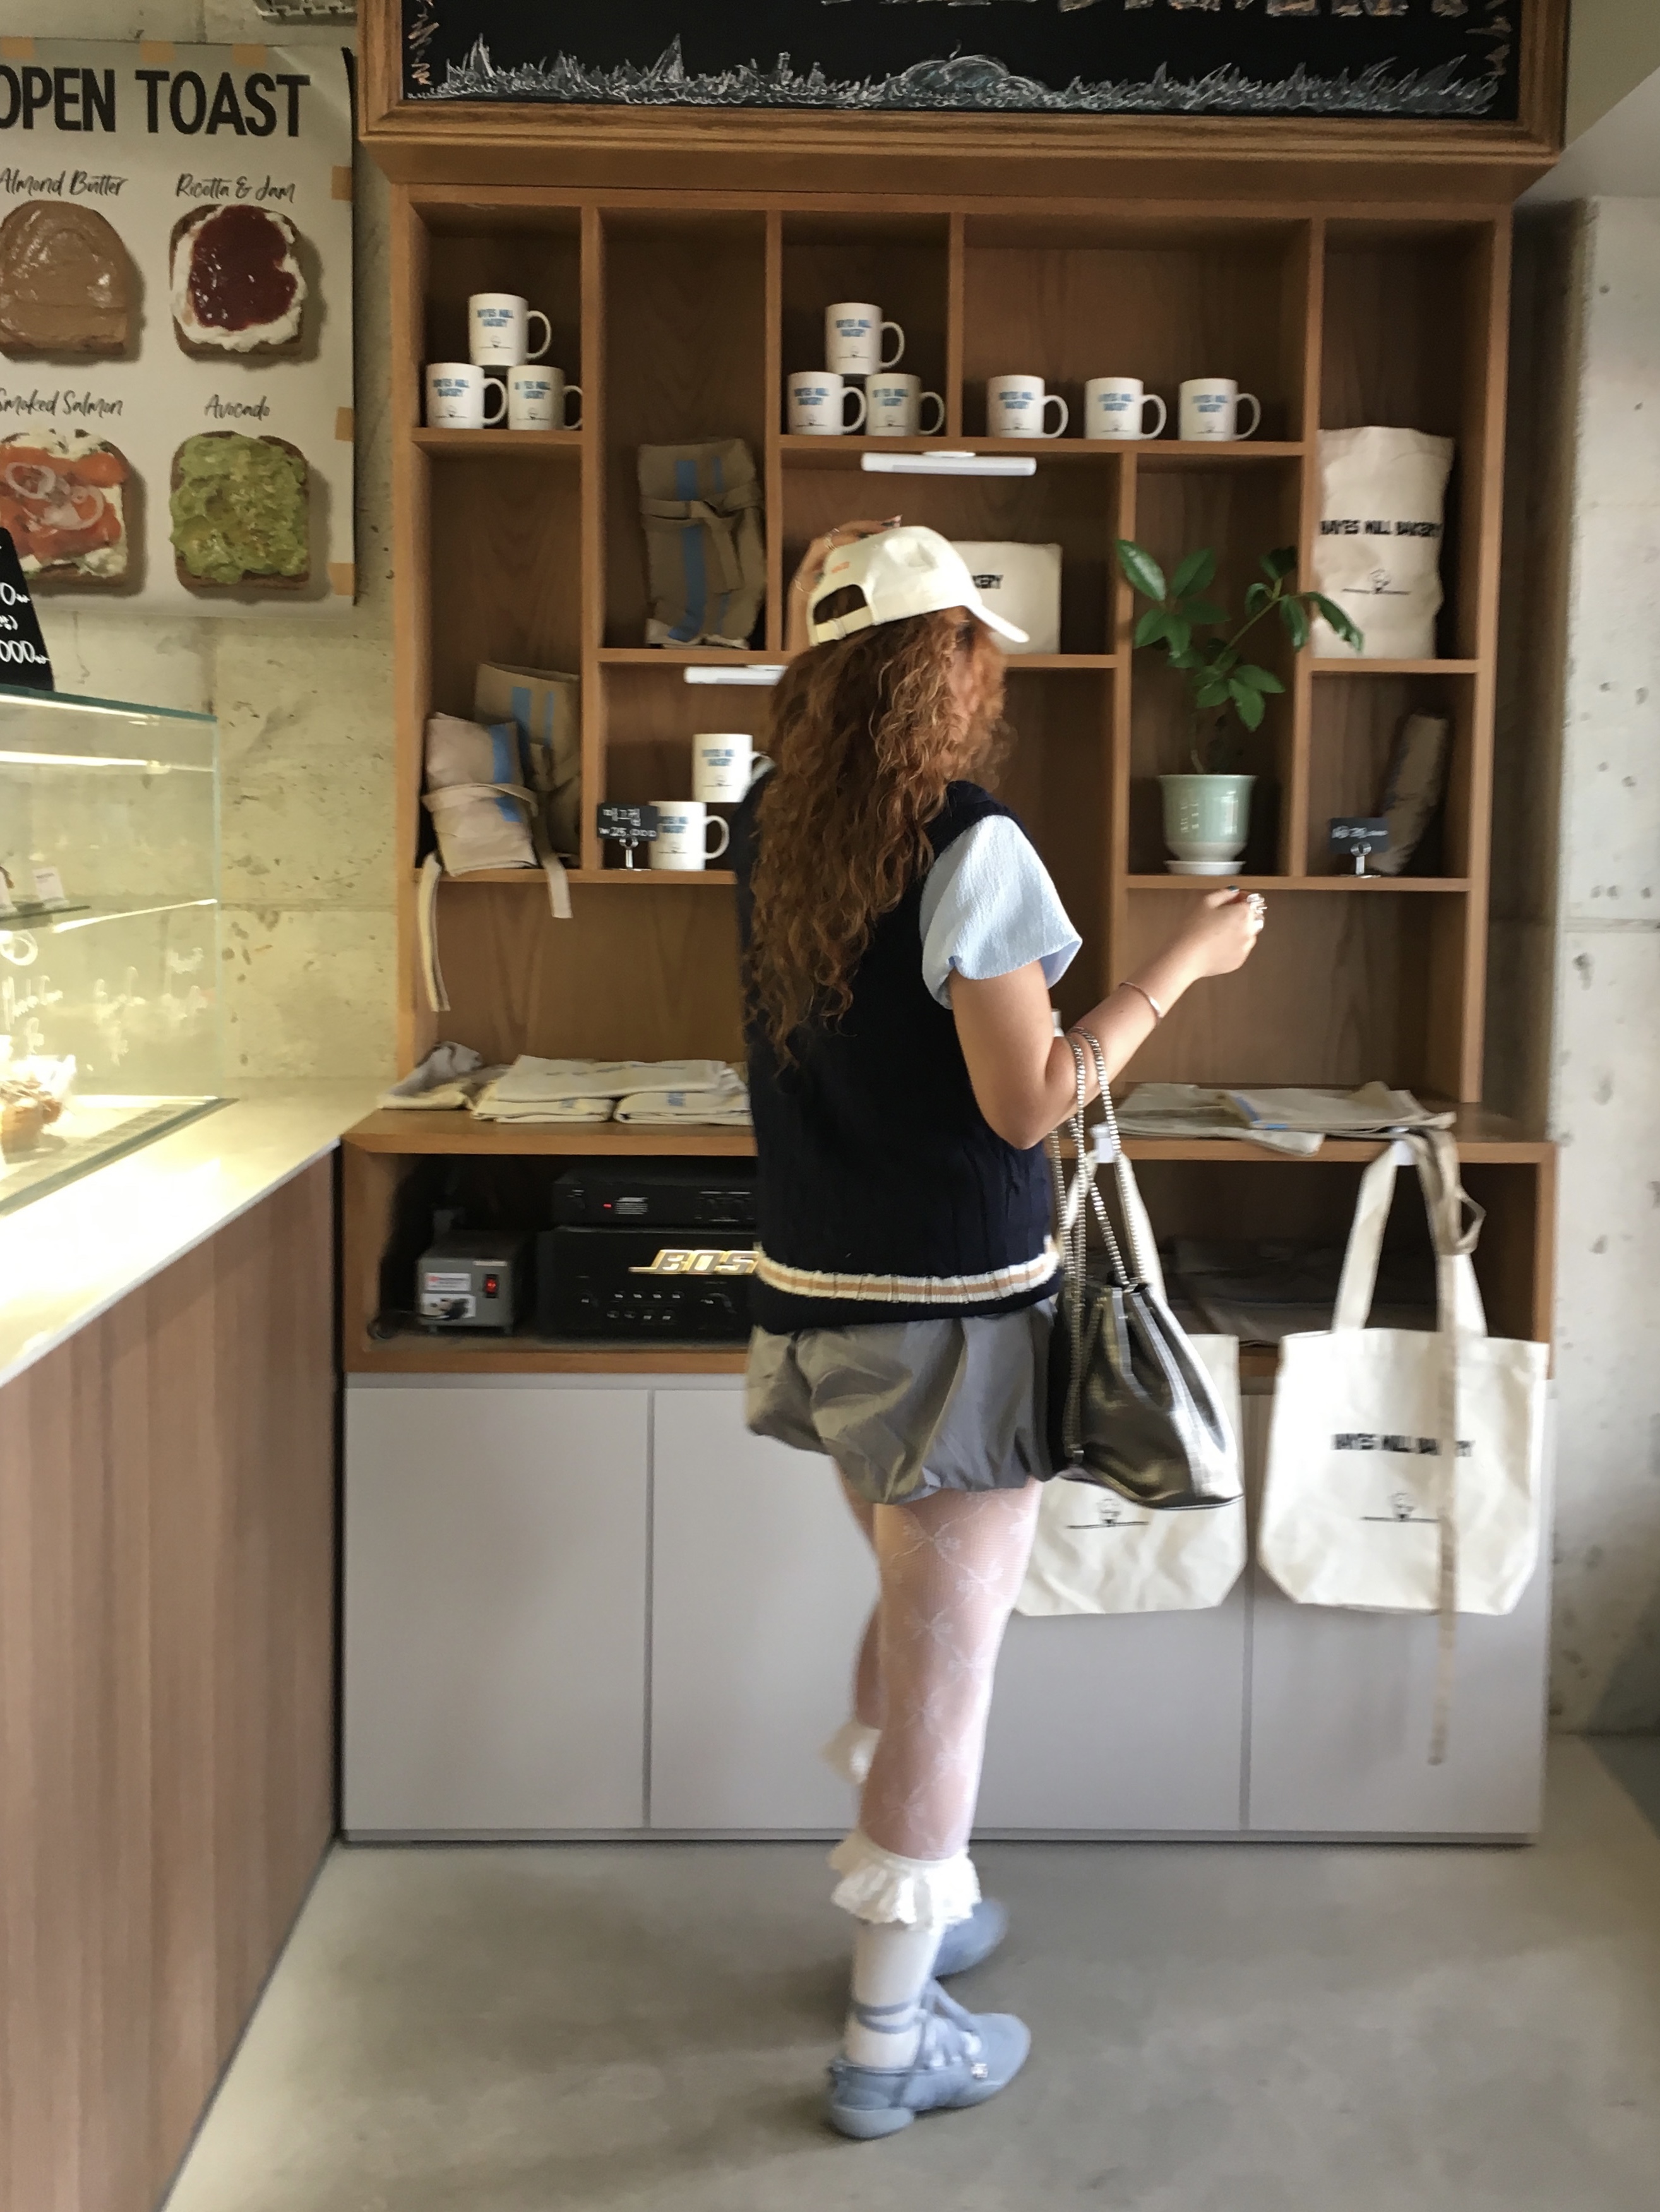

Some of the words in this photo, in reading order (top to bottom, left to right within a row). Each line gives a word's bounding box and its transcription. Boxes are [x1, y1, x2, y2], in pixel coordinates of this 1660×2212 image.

[0, 66, 116, 132] OPEN
[134, 70, 311, 138] TOAST
[0, 167, 66, 196] Almond
[69, 169, 128, 196] Butter
[176, 173, 232, 199] Ricotta
[236, 176, 253, 199] &
[255, 175, 296, 204] Jam
[63, 390, 123, 418] Salmon
[204, 394, 270, 421] Avocado
[651, 1250, 760, 1275] BOS
